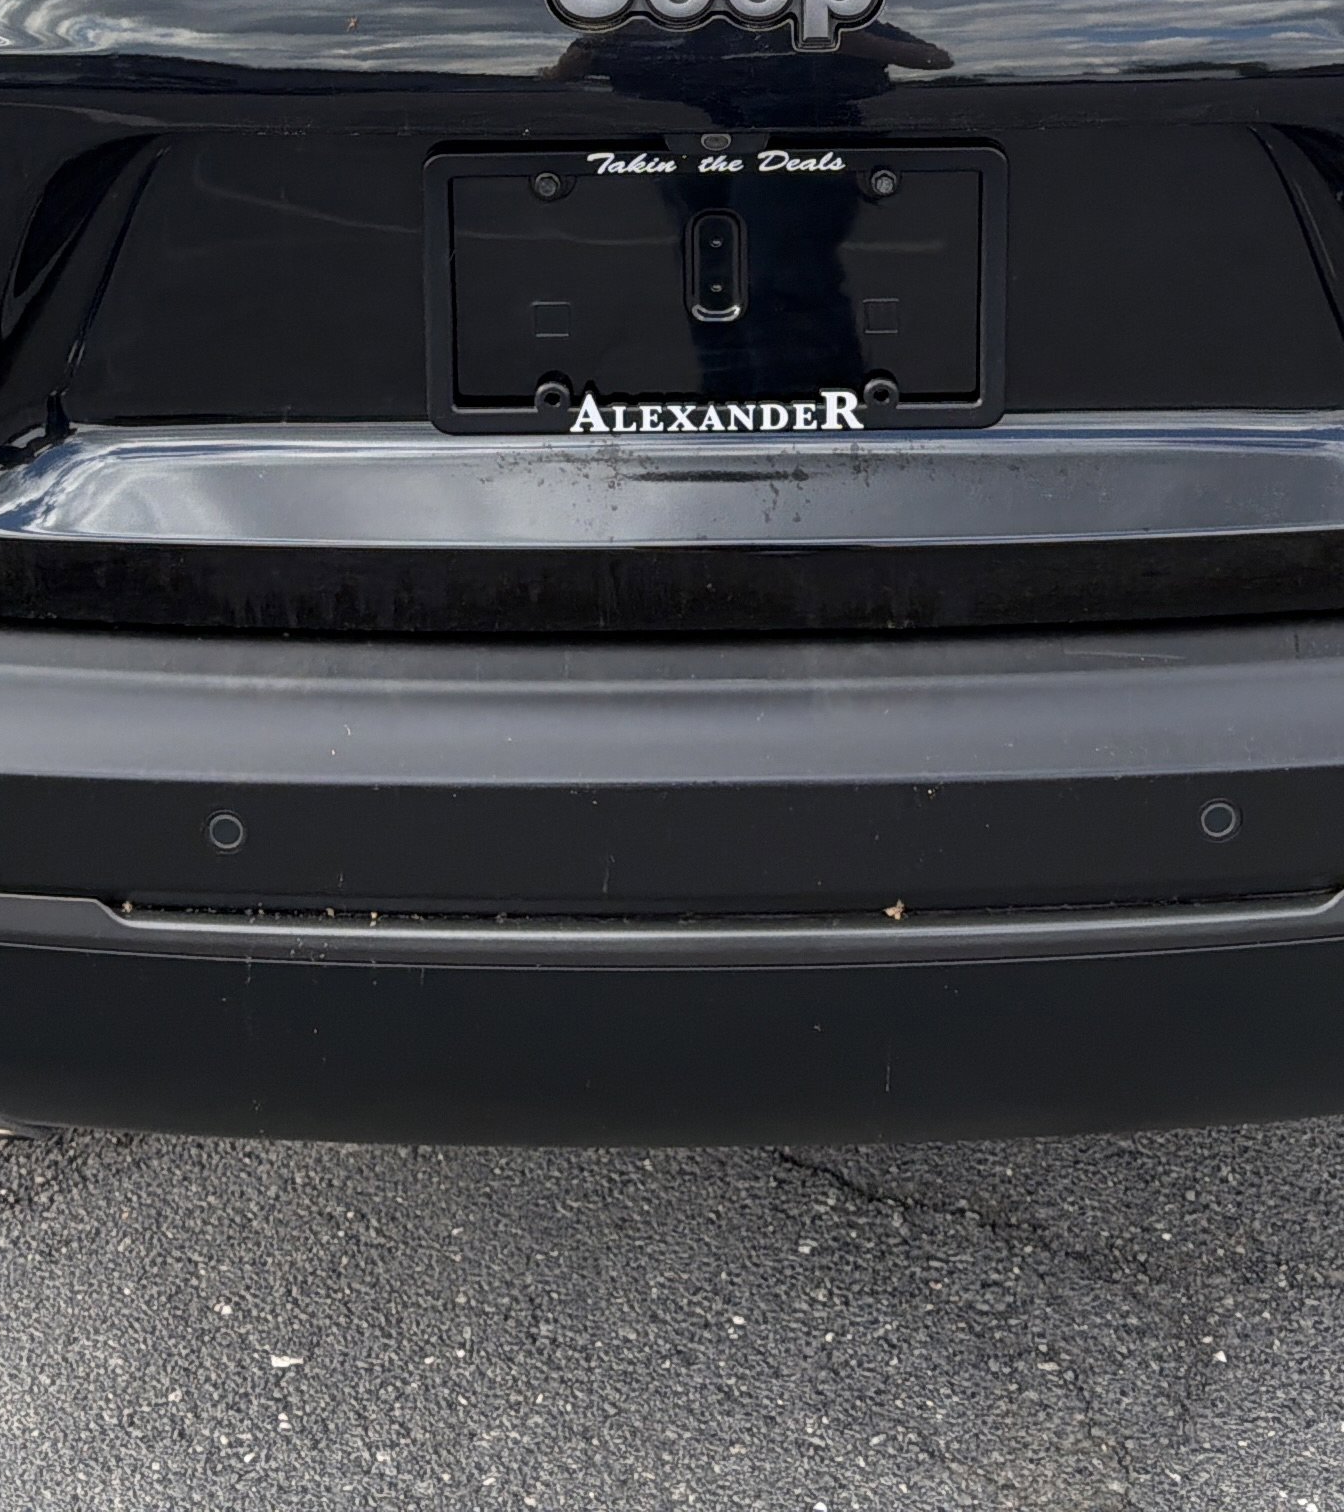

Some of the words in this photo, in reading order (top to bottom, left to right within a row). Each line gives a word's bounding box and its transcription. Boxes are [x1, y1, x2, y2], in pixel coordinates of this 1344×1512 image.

[698, 155, 744, 173] the
[757, 150, 846, 172] Deals
[569, 390, 864, 432] ALEXANDER
